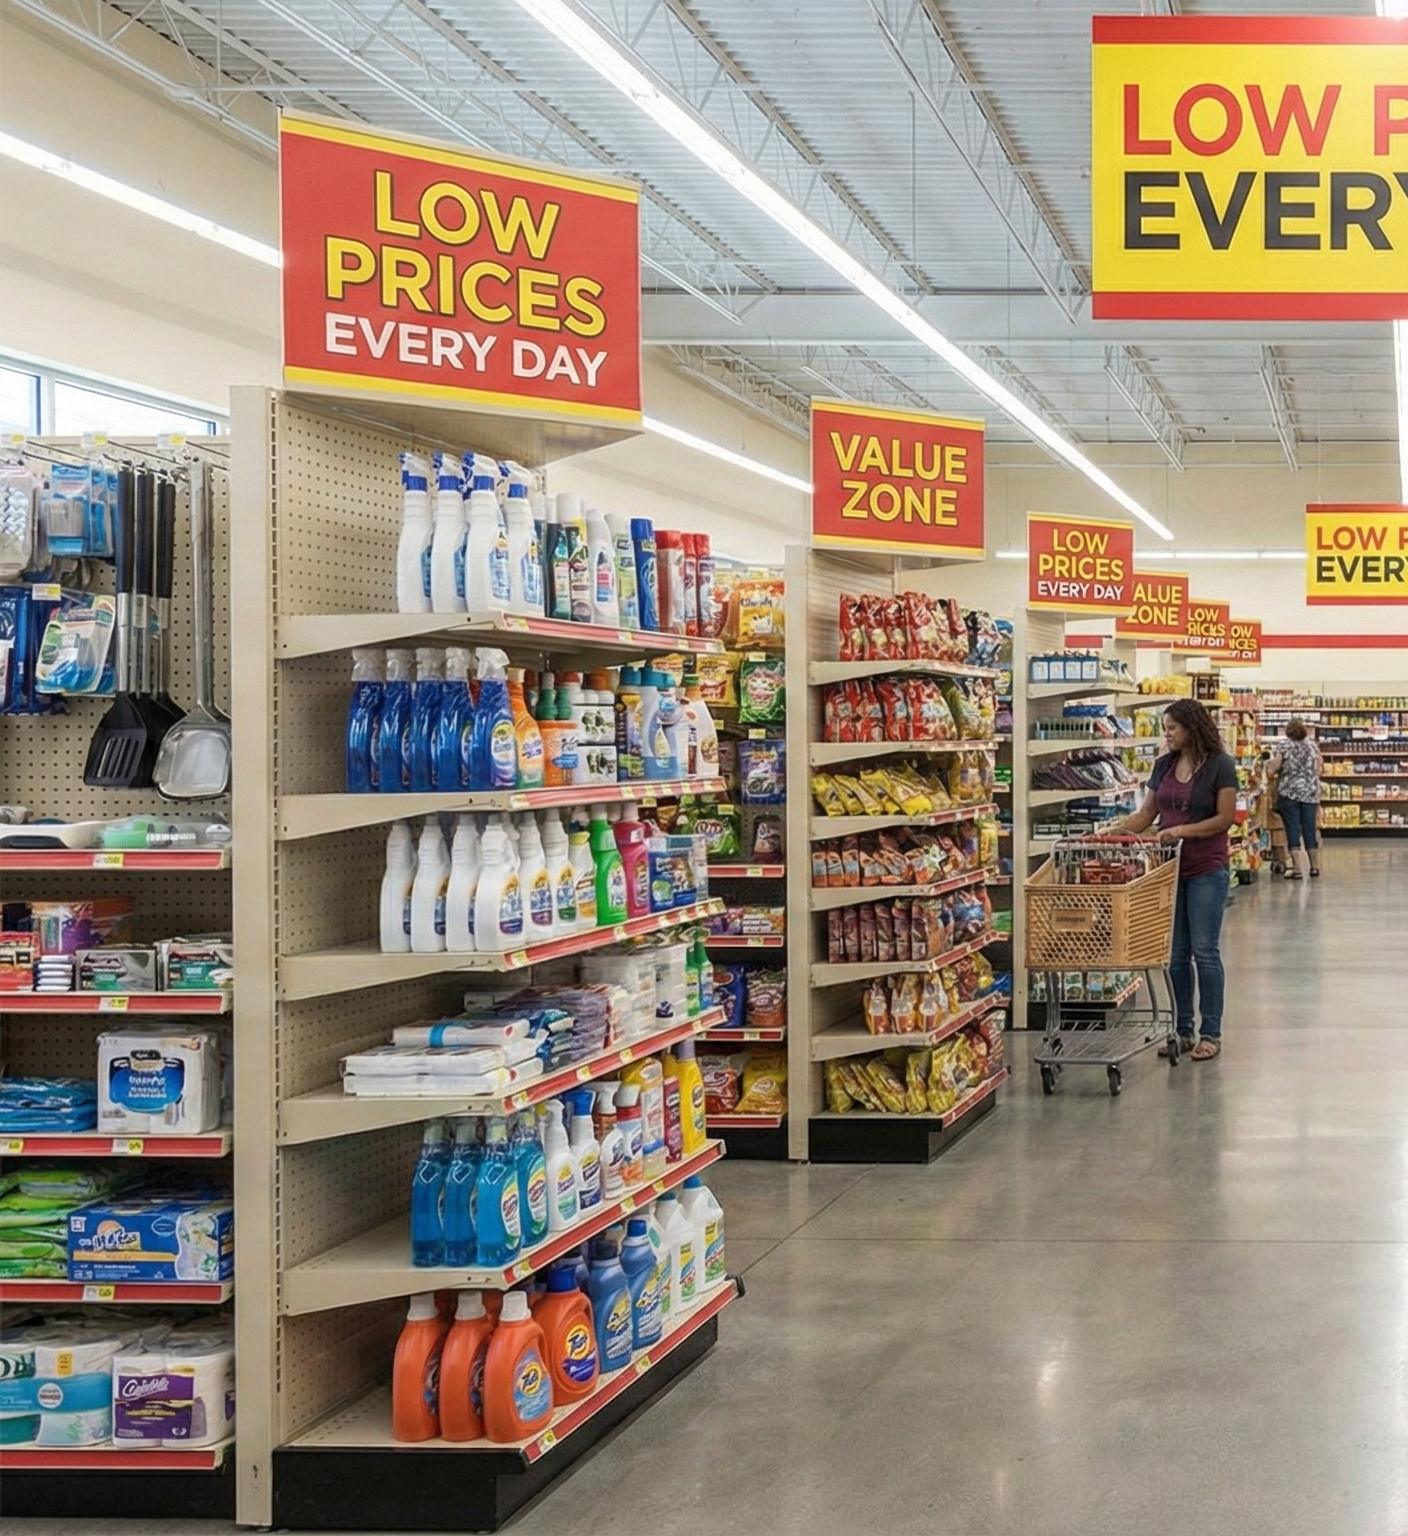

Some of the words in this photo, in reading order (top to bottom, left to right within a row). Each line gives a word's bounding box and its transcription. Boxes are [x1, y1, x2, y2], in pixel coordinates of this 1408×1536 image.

[1122, 83, 1342, 157] LOW
[375, 169, 560, 260] LOW
[325, 235, 606, 338] PRICES
[325, 312, 497, 372] EVERY
[512, 339, 608, 387] DAY
[829, 431, 969, 484] VALUE
[841, 479, 958, 527] ZONE
[1053, 529, 1109, 555] LOW
[1316, 526, 1388, 550] LOW
[1038, 554, 1124, 581] PRICES
[1037, 580, 1090, 599] EVERY
[1094, 584, 1124, 600] DAY
[1132, 582, 1183, 605] ALUE
[1188, 608, 1219, 622] LOW
[1231, 625, 1253, 638] OW
